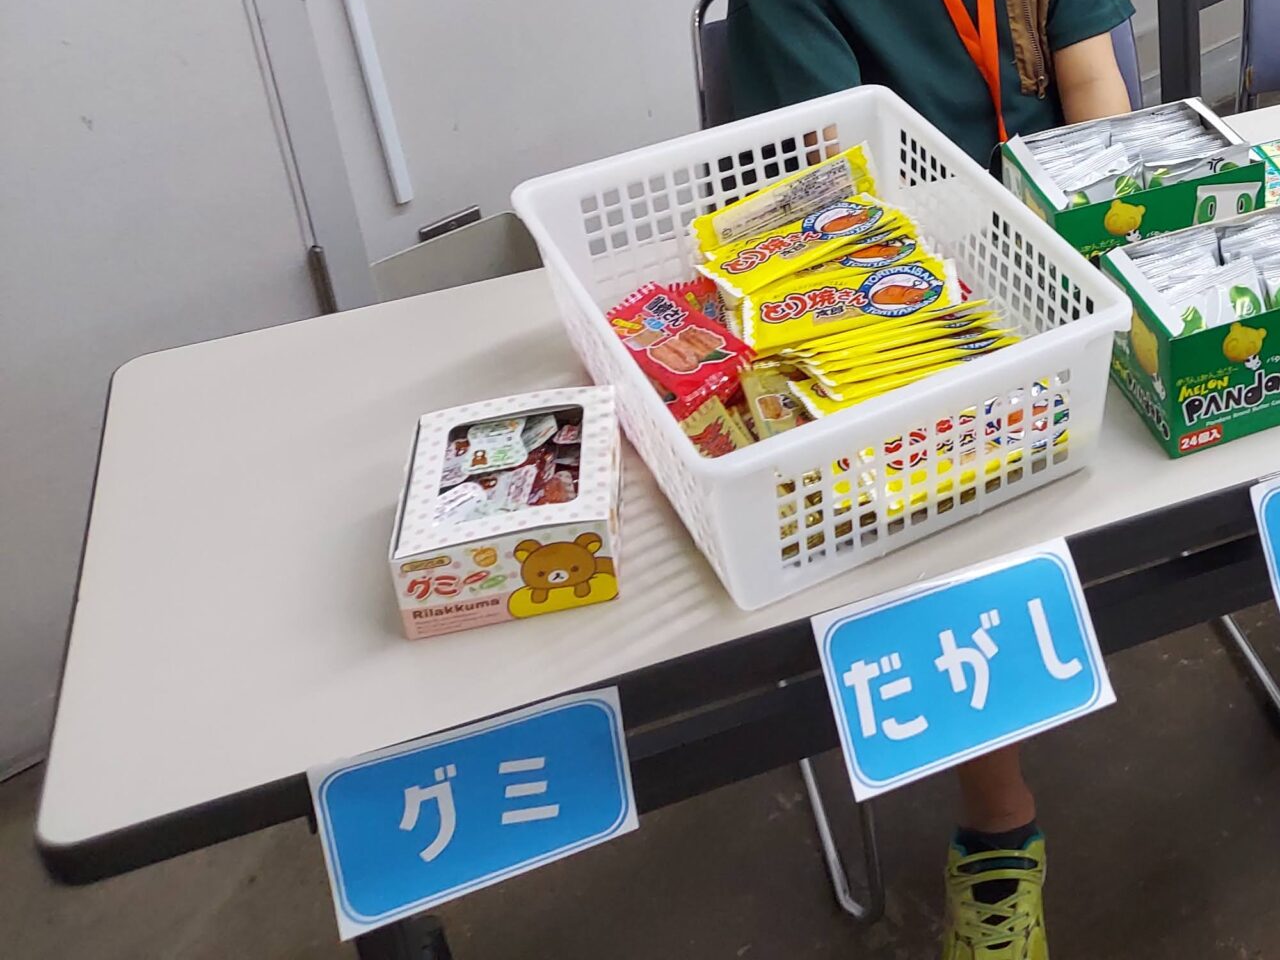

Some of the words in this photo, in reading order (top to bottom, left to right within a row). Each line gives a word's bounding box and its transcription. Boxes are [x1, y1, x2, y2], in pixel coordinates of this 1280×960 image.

[1178, 376, 1230, 402] MELON
[406, 574, 460, 601] グミ
[412, 598, 500, 620] Rilakkuma
[842, 597, 1084, 741] だがし
[399, 756, 561, 863] グミ
